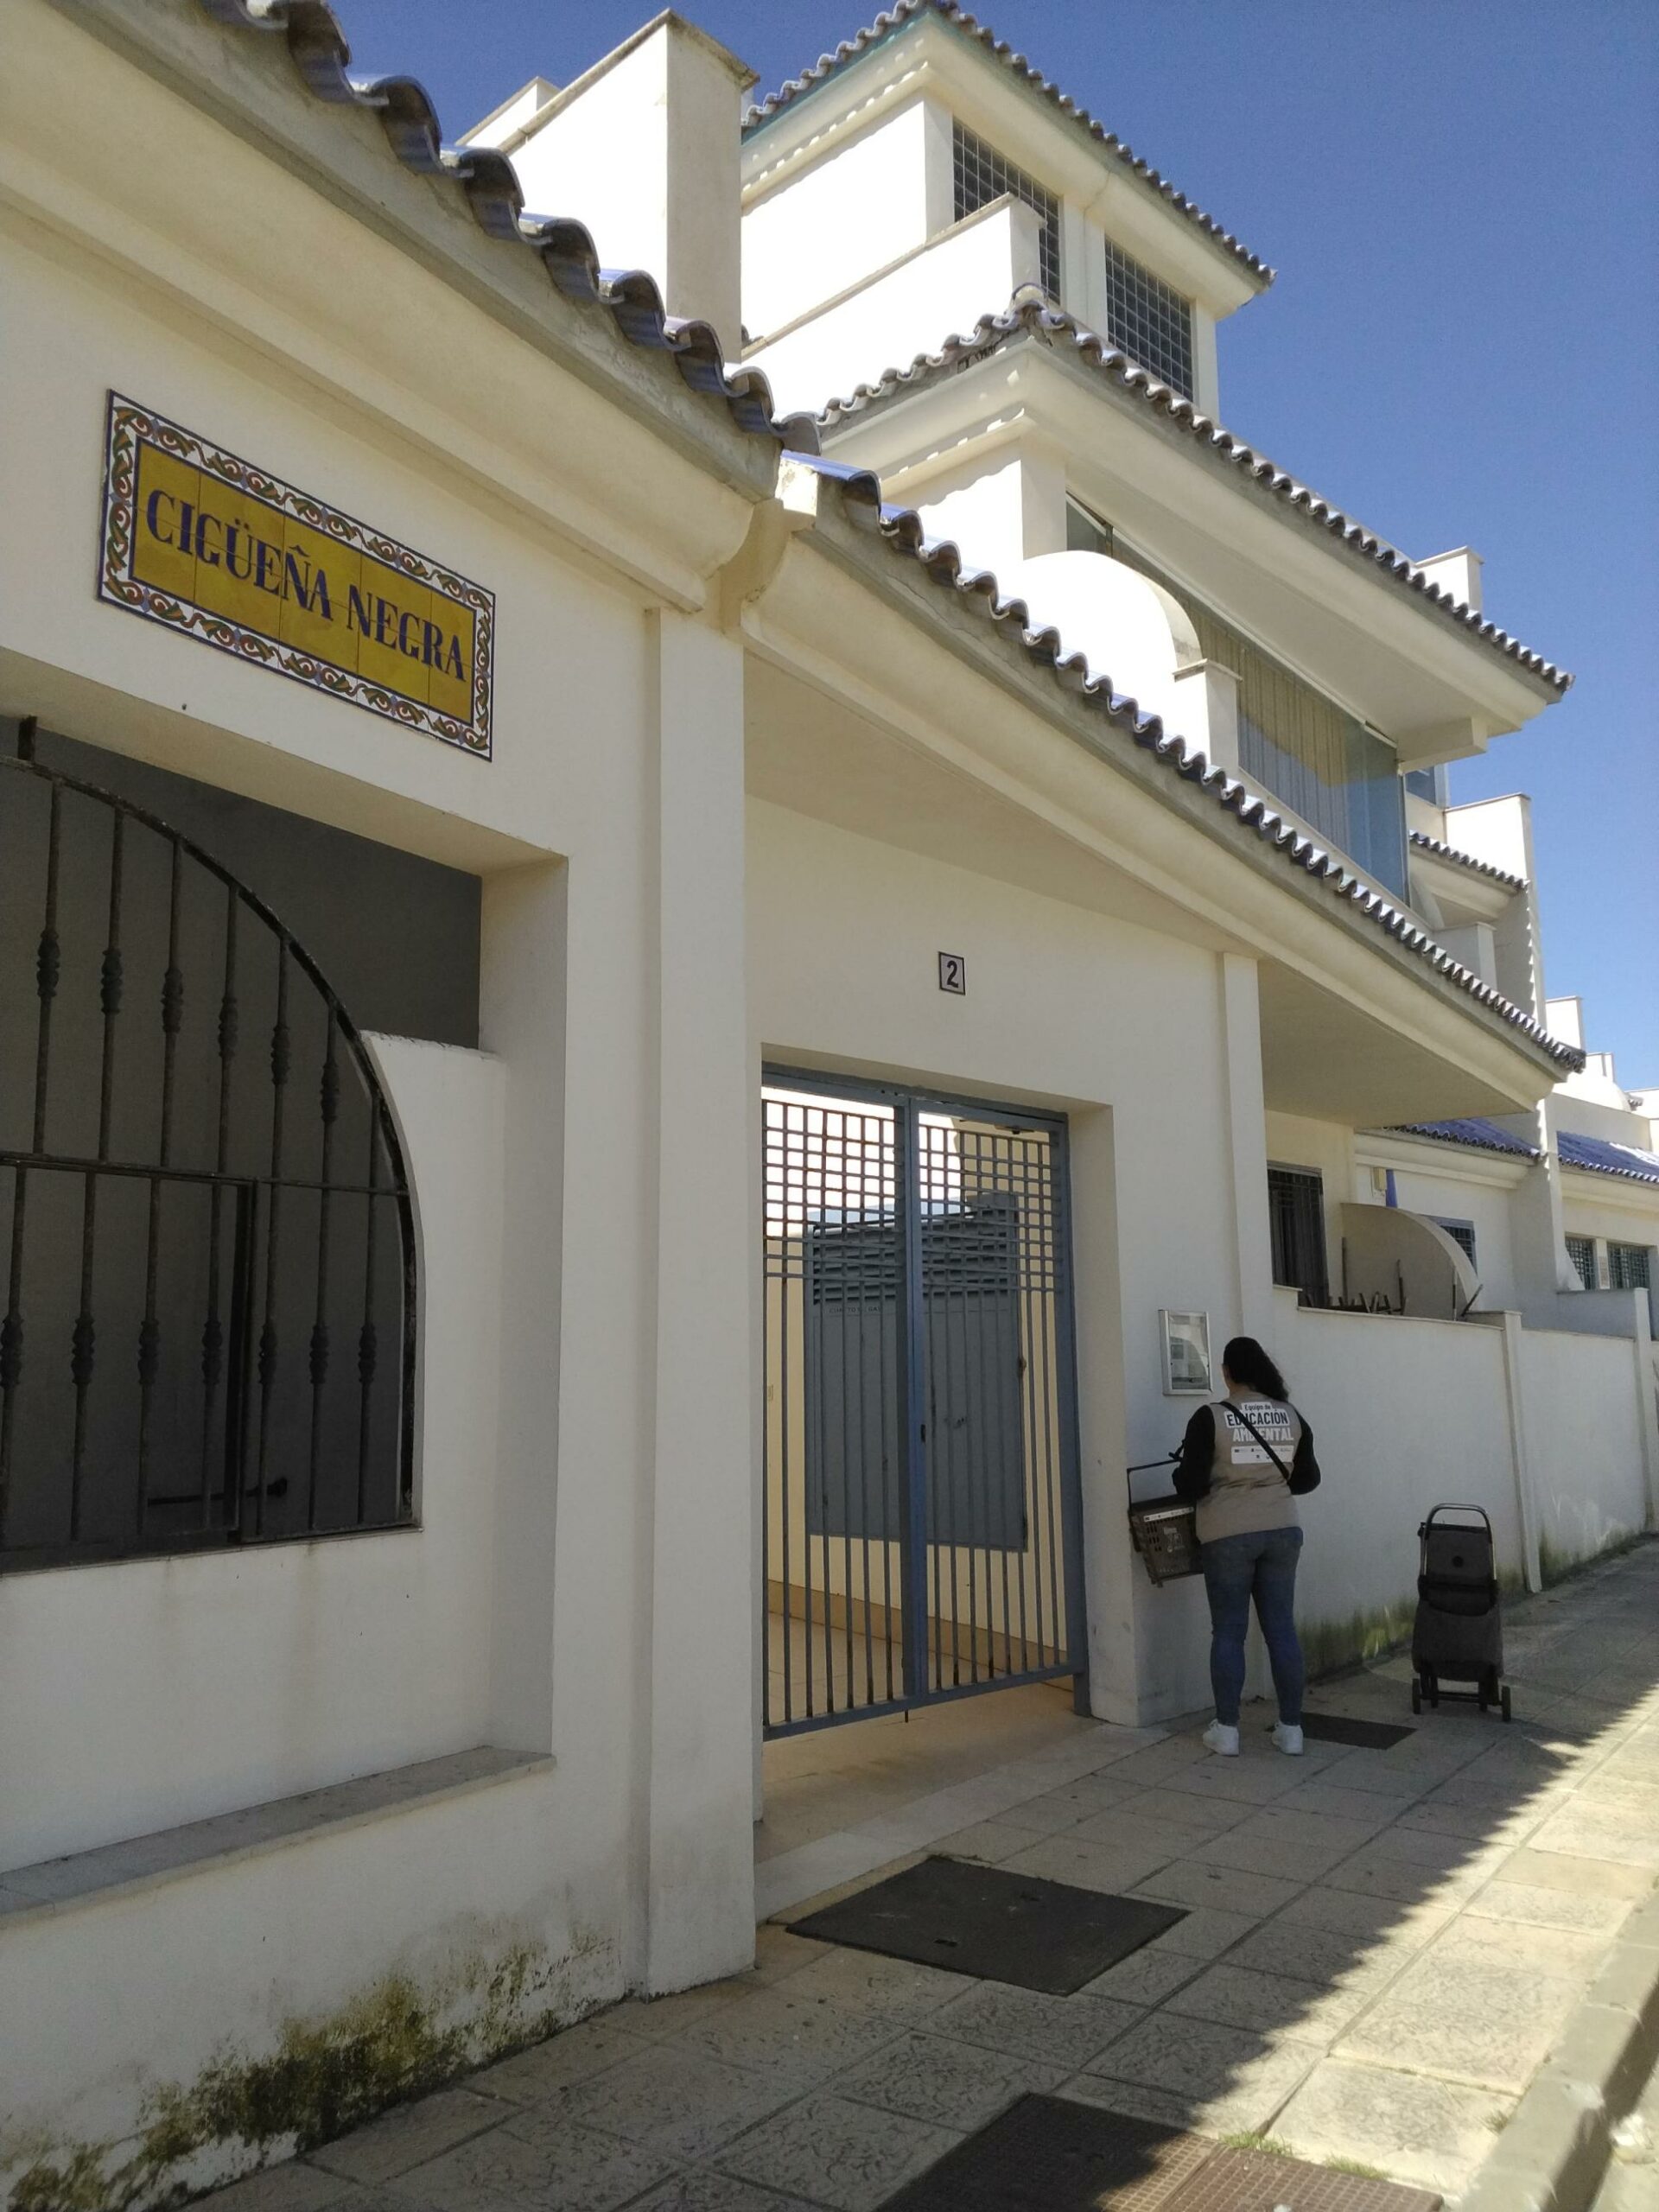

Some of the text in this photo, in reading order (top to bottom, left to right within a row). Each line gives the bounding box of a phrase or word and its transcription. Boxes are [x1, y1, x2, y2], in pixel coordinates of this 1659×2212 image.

[146, 488, 467, 683] CIGÜEÑA NEGRA
[946, 960, 959, 988] 2
[1233, 1427, 1294, 1442] AMBENTAL
